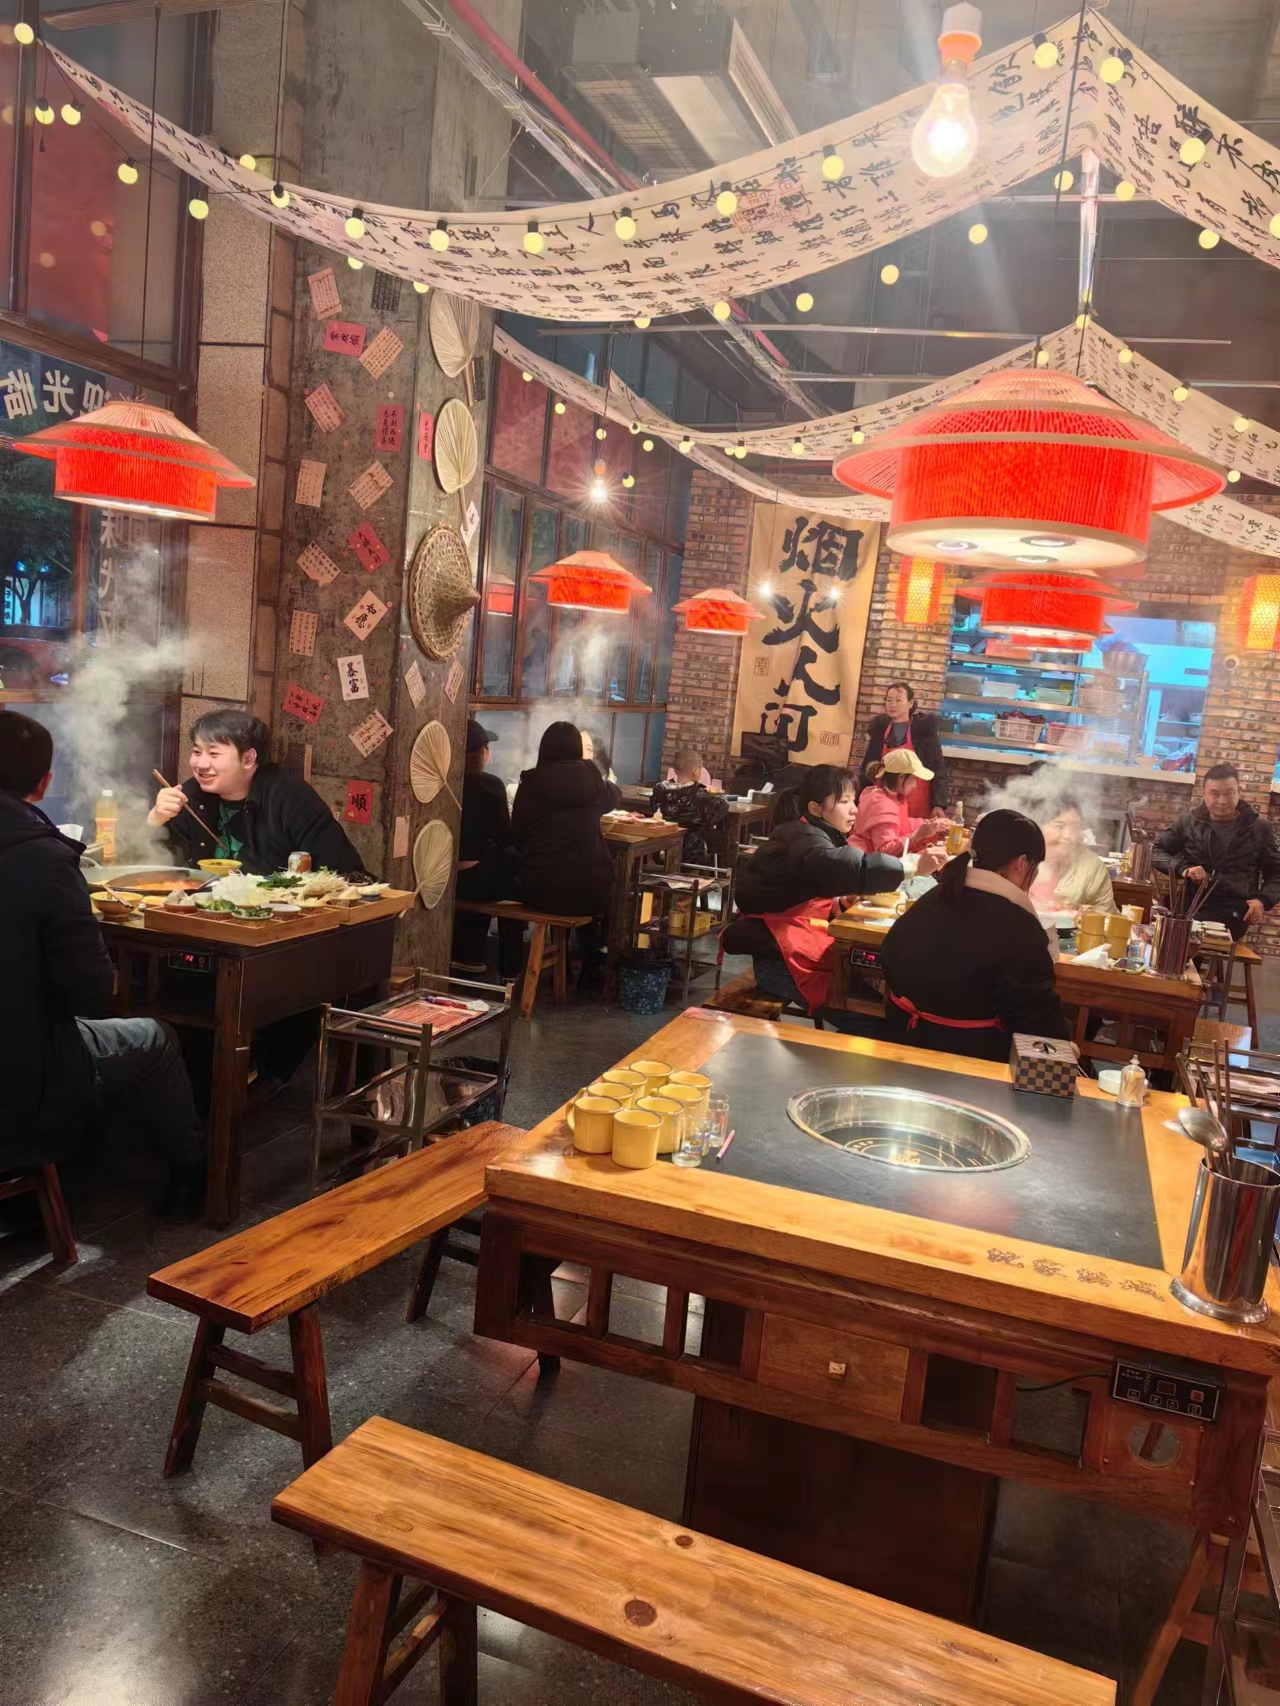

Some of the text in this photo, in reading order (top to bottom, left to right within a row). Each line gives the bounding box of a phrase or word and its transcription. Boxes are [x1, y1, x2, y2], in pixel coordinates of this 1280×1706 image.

[355, 603, 377, 629] 如愿
[346, 661, 360, 694] 暴富
[351, 793, 368, 813] 顺
